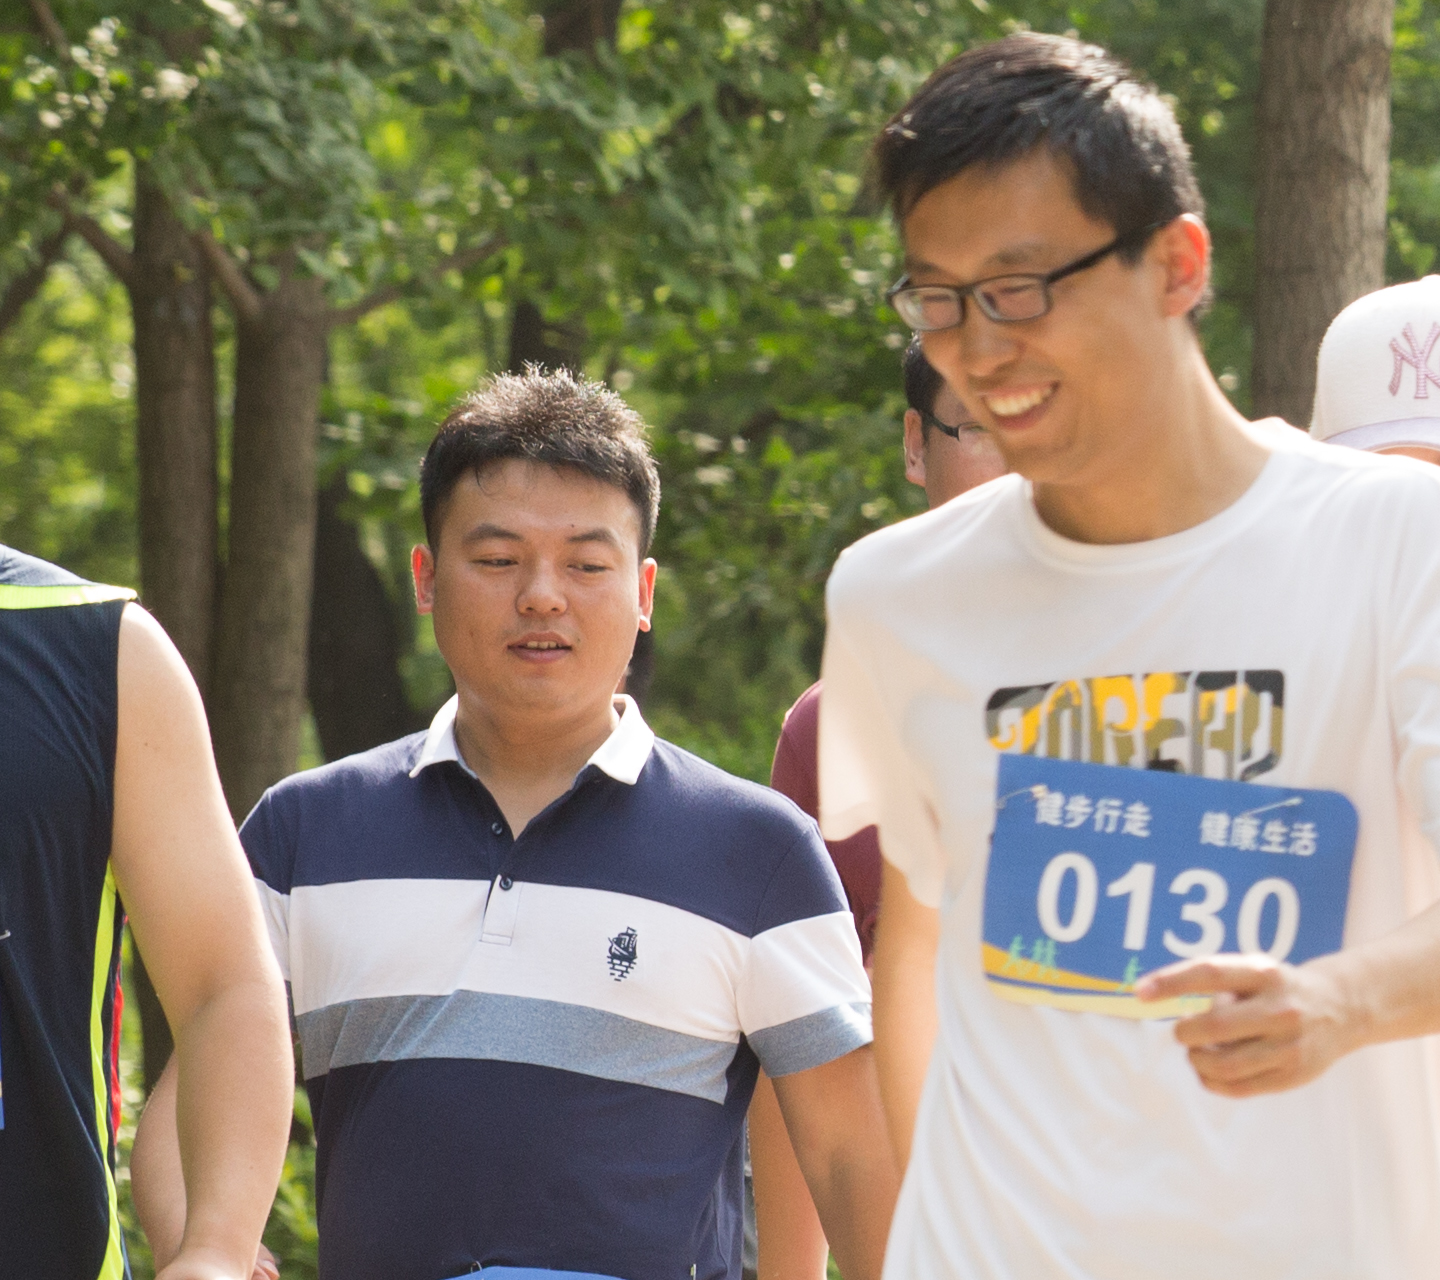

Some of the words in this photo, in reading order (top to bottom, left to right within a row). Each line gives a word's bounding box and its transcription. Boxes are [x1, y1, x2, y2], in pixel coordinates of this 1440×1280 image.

[1035, 791, 1152, 838] 健步行走
[1199, 810, 1319, 857] 健康生活
[1036, 851, 1300, 963] 0130
